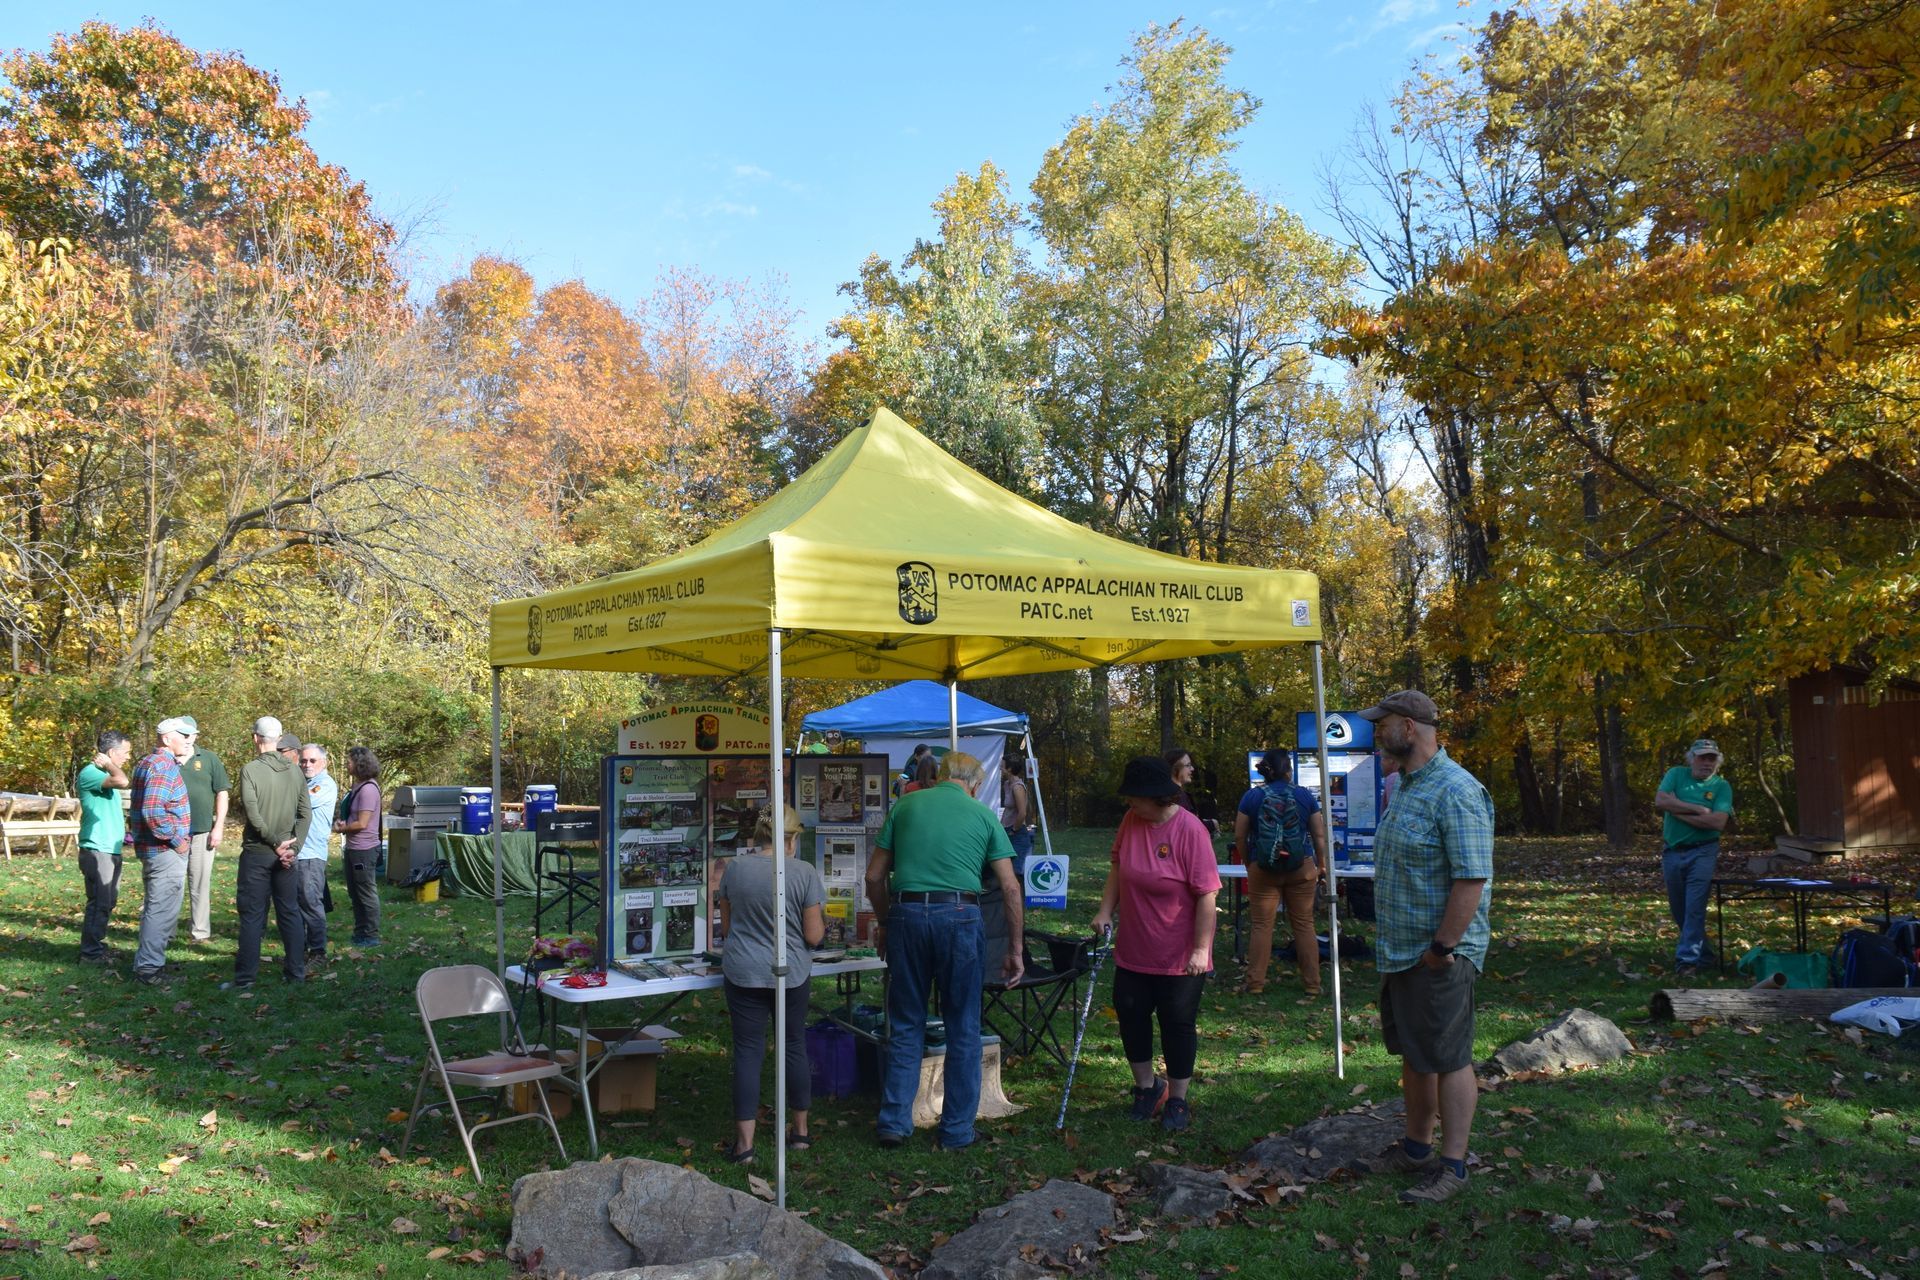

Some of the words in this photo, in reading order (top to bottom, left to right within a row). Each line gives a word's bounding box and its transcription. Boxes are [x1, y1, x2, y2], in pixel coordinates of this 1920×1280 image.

[948, 572, 1038, 593] POTOMAC
[1042, 576, 1156, 598] APPALACHIAN
[1159, 582, 1203, 601] TRAIL
[1205, 585, 1245, 602] CLUB
[545, 606, 584, 625] POTOMAC
[585, 592, 646, 618] APPALACHIAN
[645, 586, 675, 605] TRAIL
[677, 577, 705, 598] CLUB
[1020, 601, 1094, 621] PATC.net
[1130, 605, 1190, 624] Est.1927
[573, 624, 608, 642] PATC.net
[628, 612, 667, 633] Est.1927
[621, 710, 668, 730] POTOMAC
[671, 706, 733, 716] APPALACHIAN
[735, 706, 761, 723] TRAIL
[629, 741, 655, 750] Est.
[659, 740, 688, 750] 1927
[725, 740, 770, 750] PATC.ne
